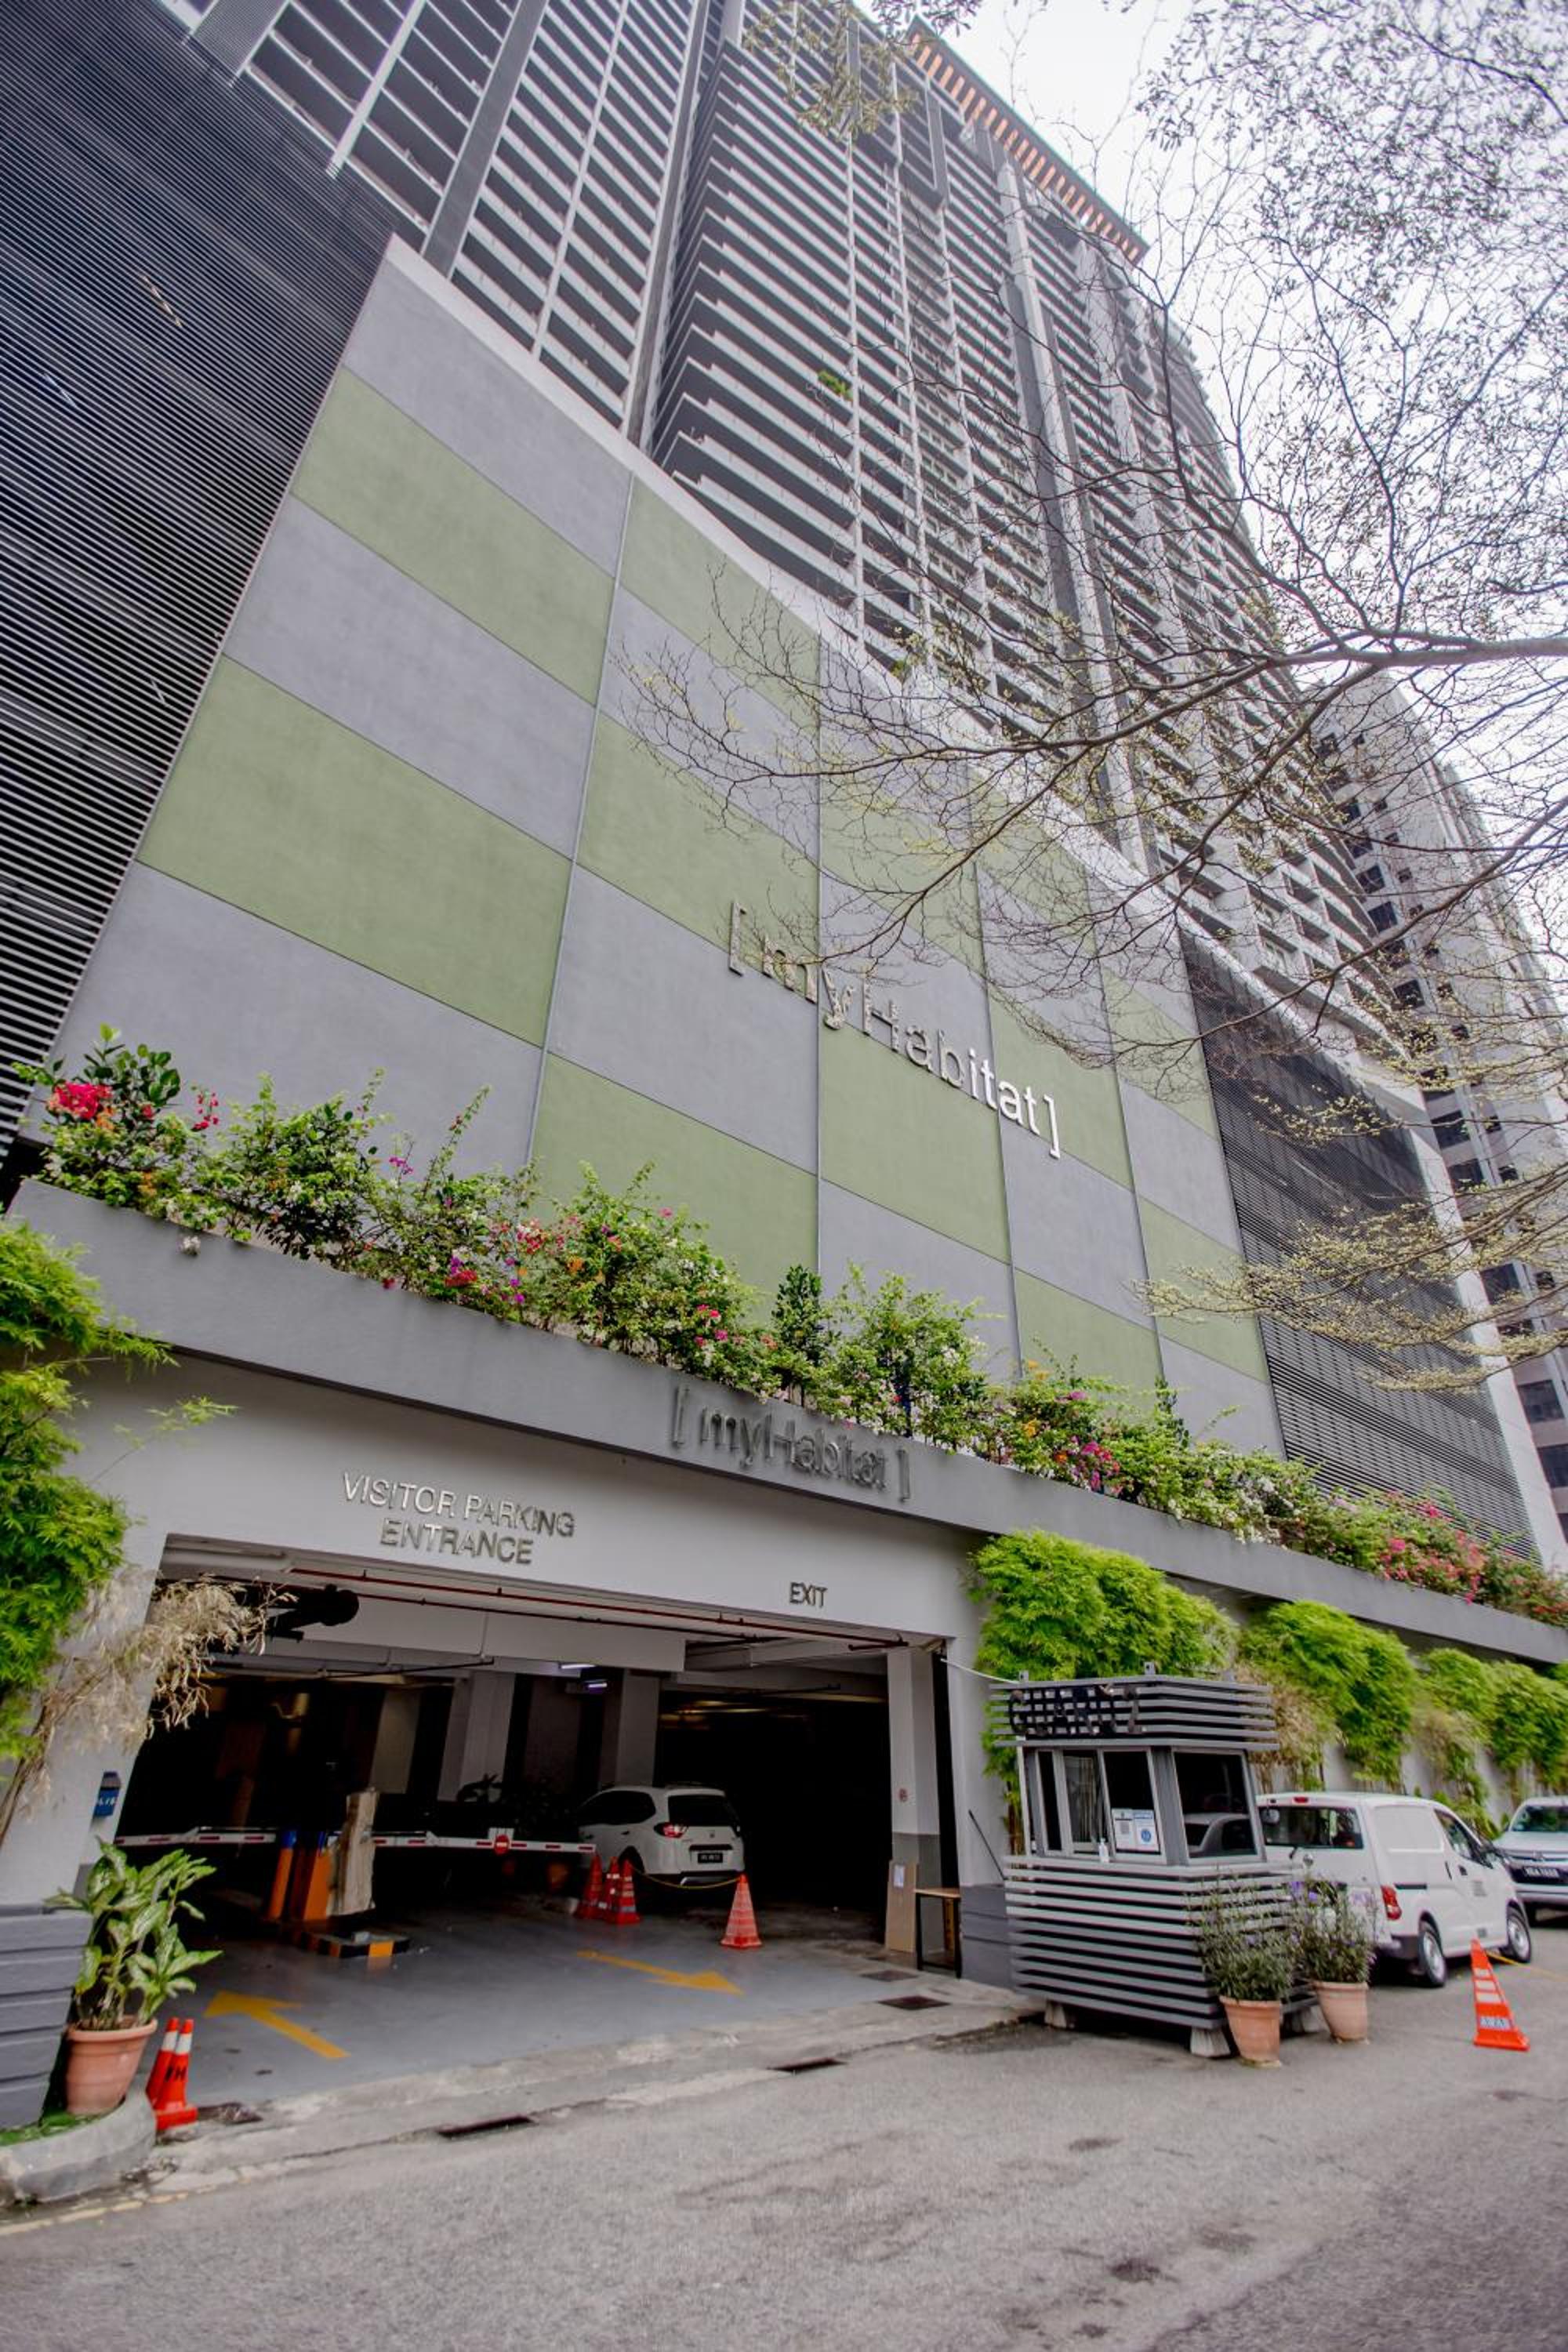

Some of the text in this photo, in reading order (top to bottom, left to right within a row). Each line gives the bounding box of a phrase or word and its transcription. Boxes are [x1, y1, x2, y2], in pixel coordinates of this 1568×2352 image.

[343, 1471, 576, 1538] VISITOR PARKING
[379, 1517, 534, 1565] ENTRANCE
[789, 1582, 828, 1608] EXIT
